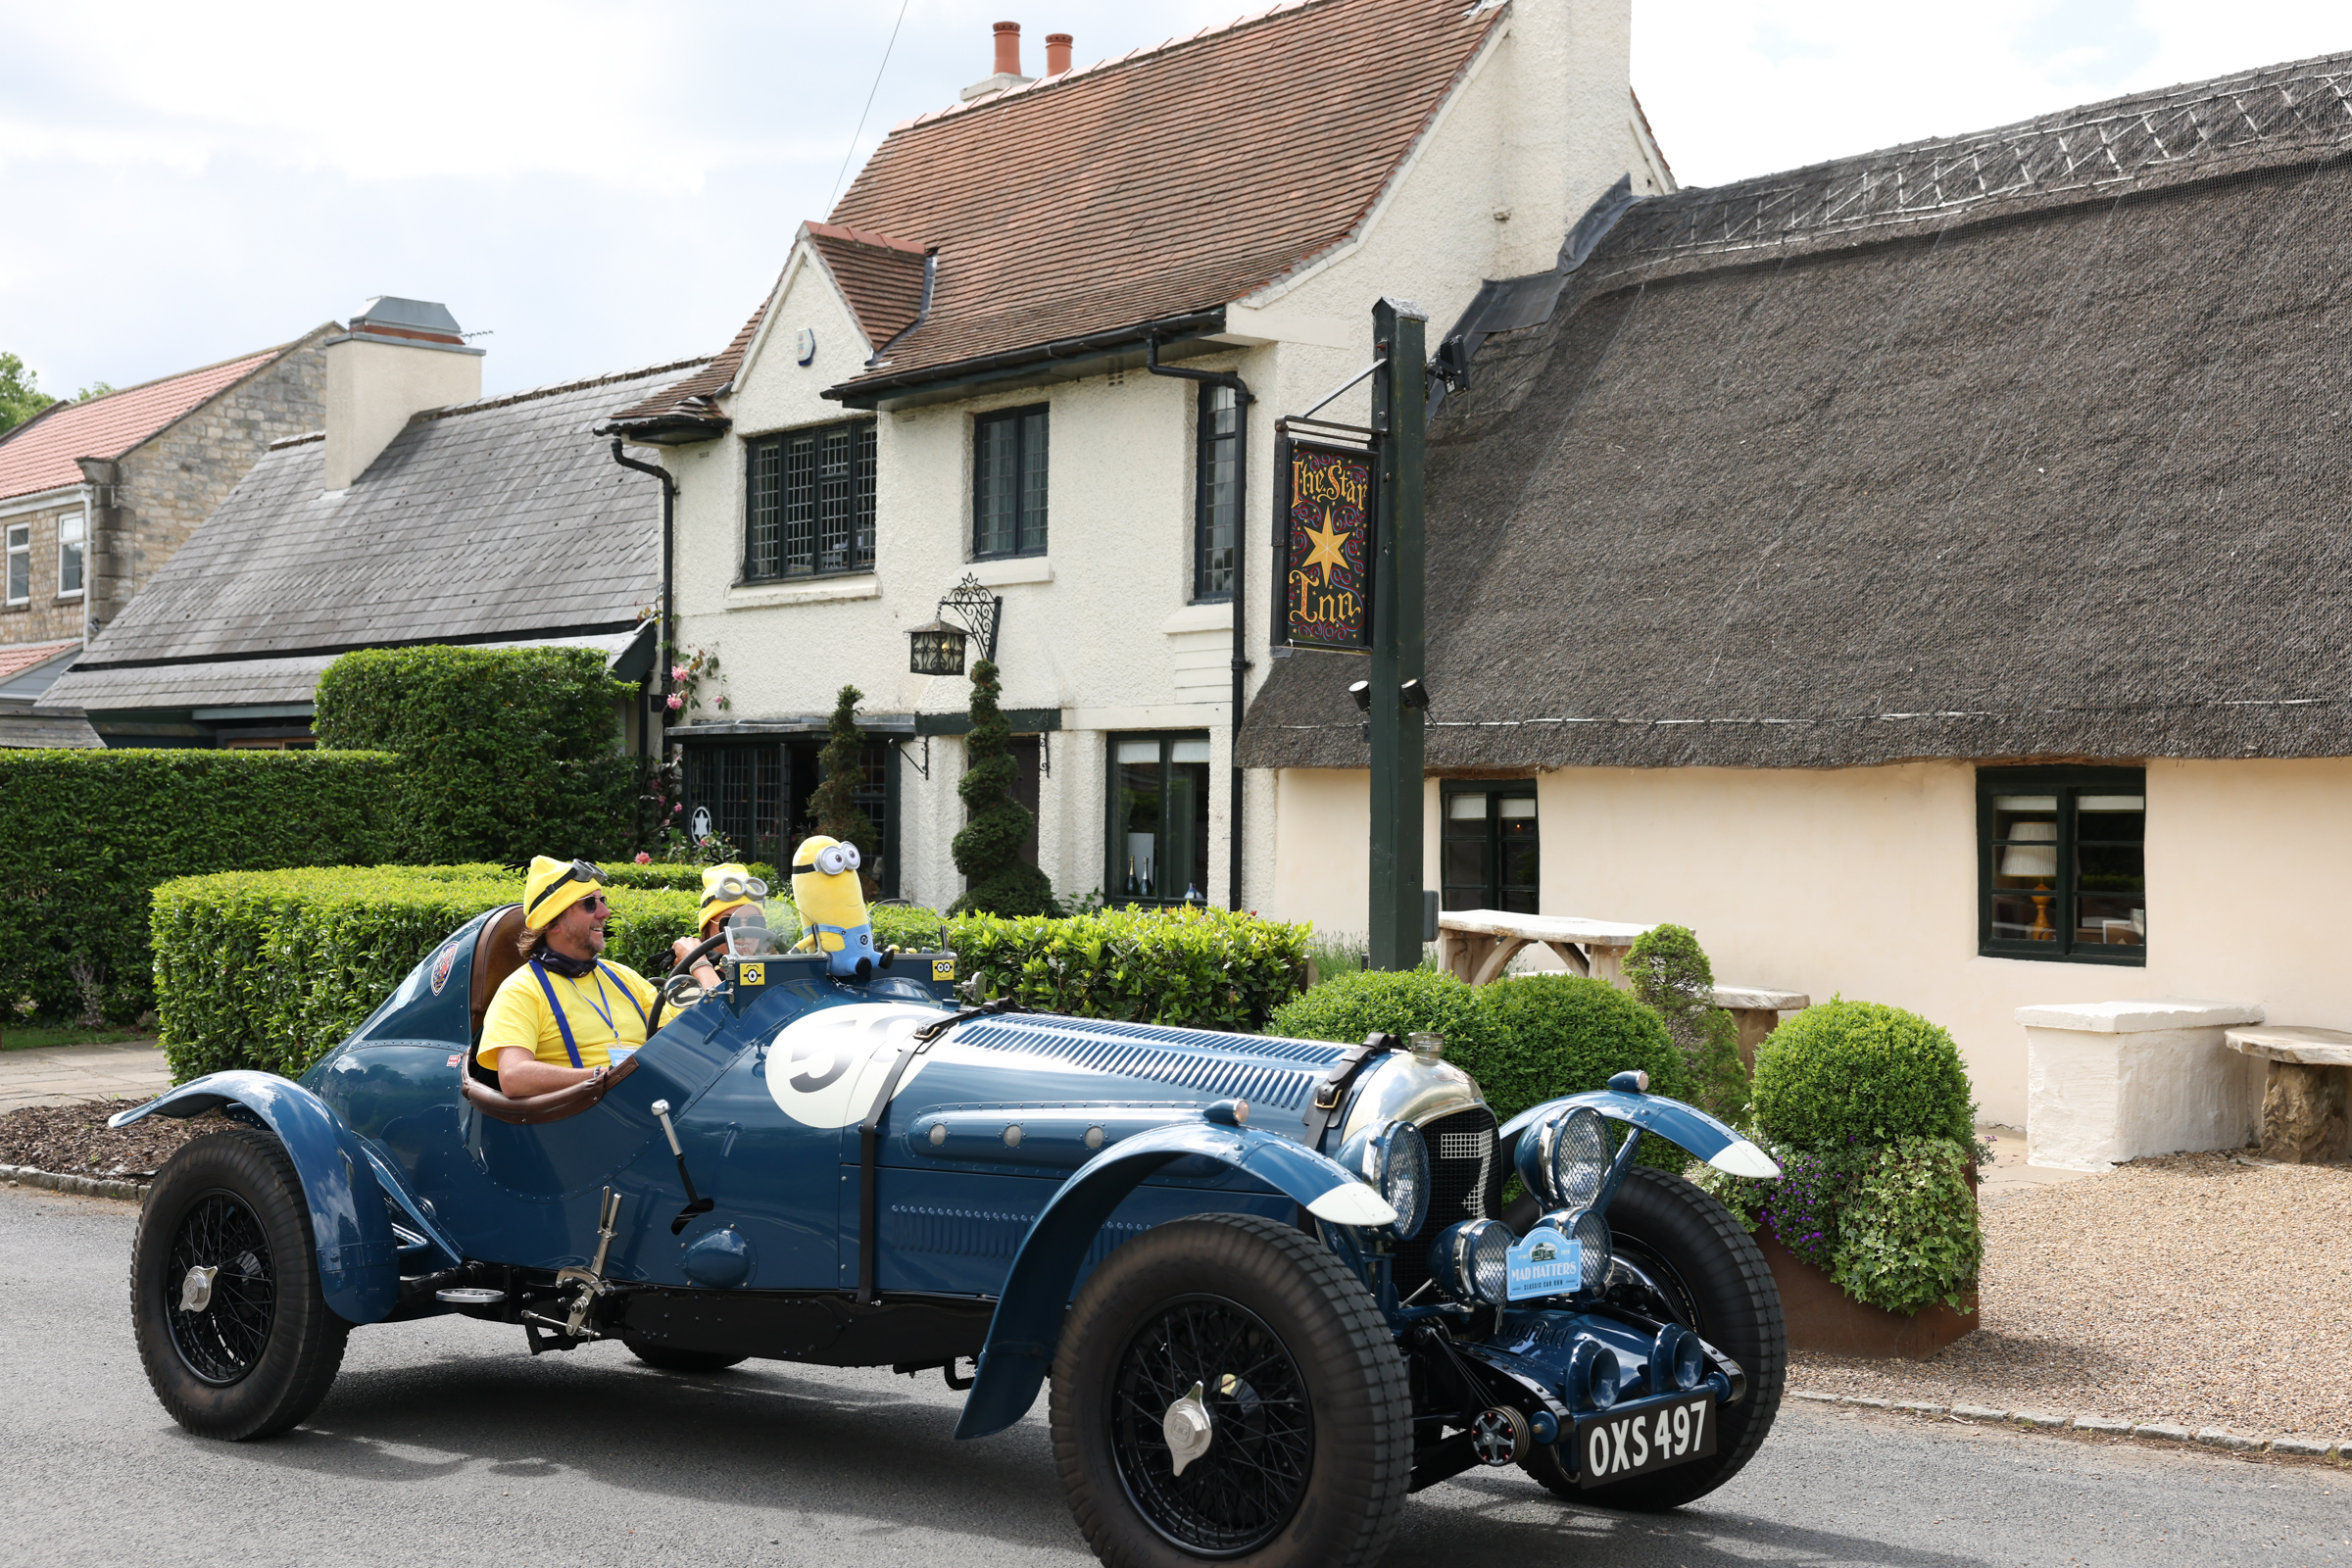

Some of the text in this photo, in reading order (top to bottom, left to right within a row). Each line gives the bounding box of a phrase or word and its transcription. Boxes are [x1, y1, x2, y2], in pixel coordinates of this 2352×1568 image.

[1291, 460, 1368, 512] The Star
[1289, 569, 1361, 624] Inn
[1511, 1261, 1577, 1282] MAD HATTERS
[1524, 1282, 1542, 1291] CLASSIC
[1589, 1399, 1707, 1477] OXS 497
